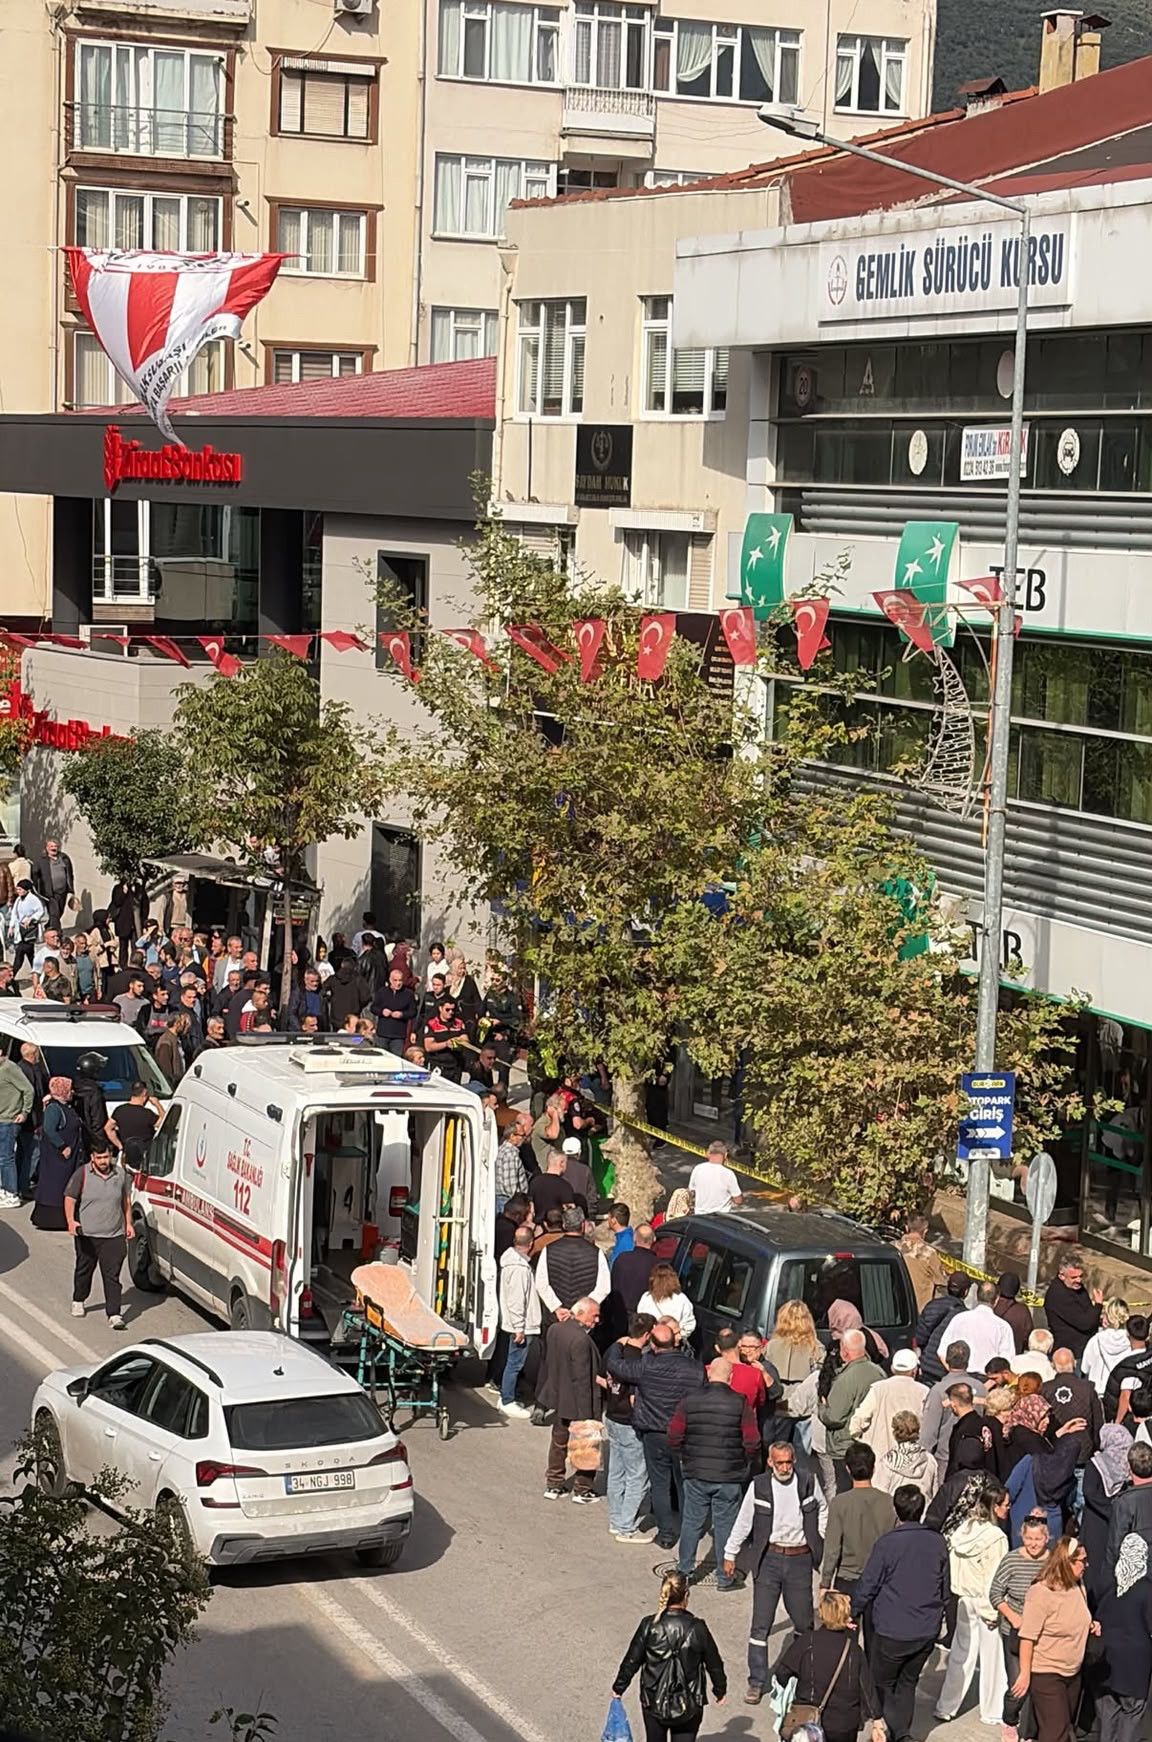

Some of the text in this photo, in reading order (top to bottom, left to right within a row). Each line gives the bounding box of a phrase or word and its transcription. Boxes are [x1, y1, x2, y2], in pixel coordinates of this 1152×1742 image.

[856, 233, 1064, 302] GEMLİK SÜRÜCÜ KURSU
[965, 919, 1024, 971] TB
[969, 1106, 1004, 1122] GİRİŞ
[234, 1179, 251, 1216] 112
[293, 1474, 352, 1489] 34 NGJ 998
